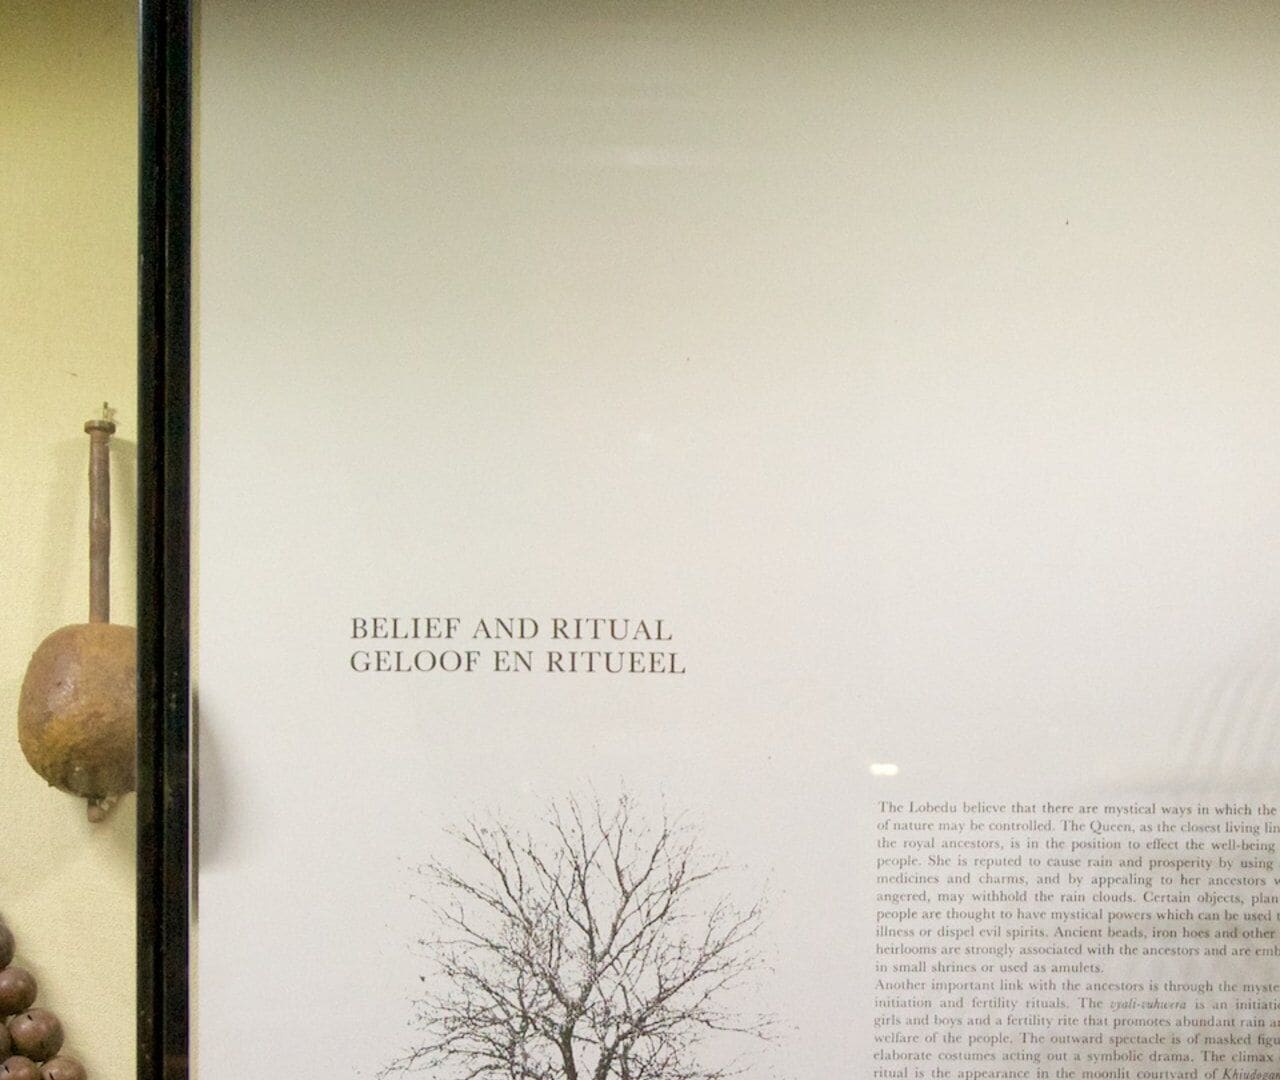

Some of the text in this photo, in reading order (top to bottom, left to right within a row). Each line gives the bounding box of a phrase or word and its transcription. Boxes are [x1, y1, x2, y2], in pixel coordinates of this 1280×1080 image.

[352, 616, 672, 640] BELIEF AND RITUAL
[350, 649, 686, 673] GELOOF EN RITUEEL
[879, 800, 904, 812] The
[910, 800, 957, 813] Lobedu
[963, 800, 1006, 813] believe
[1012, 801, 1036, 813] that
[1042, 801, 1074, 814] there
[1079, 805, 1099, 814] are
[1104, 802, 1156, 818] mystical
[1162, 805, 1193, 818] ways
[1198, 802, 1210, 815] in
[1215, 803, 1253, 815] which
[1258, 803, 1277, 815] the
[877, 818, 889, 830] of
[894, 820, 935, 831] nature
[939, 822, 966, 834] may
[970, 819, 985, 831] be
[989, 819, 1055, 831] controlled.
[1064, 819, 1086, 832] The
[1090, 819, 1135, 835] Queen,
[1140, 823, 1153, 832] as
[1157, 820, 1177, 832] the
[1181, 820, 1221, 833] closest
[1226, 820, 1261, 836] living
[876, 942, 937, 955] heirlooms
[941, 946, 961, 955] are
[965, 942, 1015, 958] strongly
[1020, 943, 1083, 955] associated
[1088, 943, 1115, 955] with
[1120, 943, 1139, 955] the
[1143, 945, 1200, 956] ancestors
[1205, 943, 1228, 956] and
[1232, 947, 1252, 956] are
[876, 960, 1105, 973] in small shrines or used as amulets.
